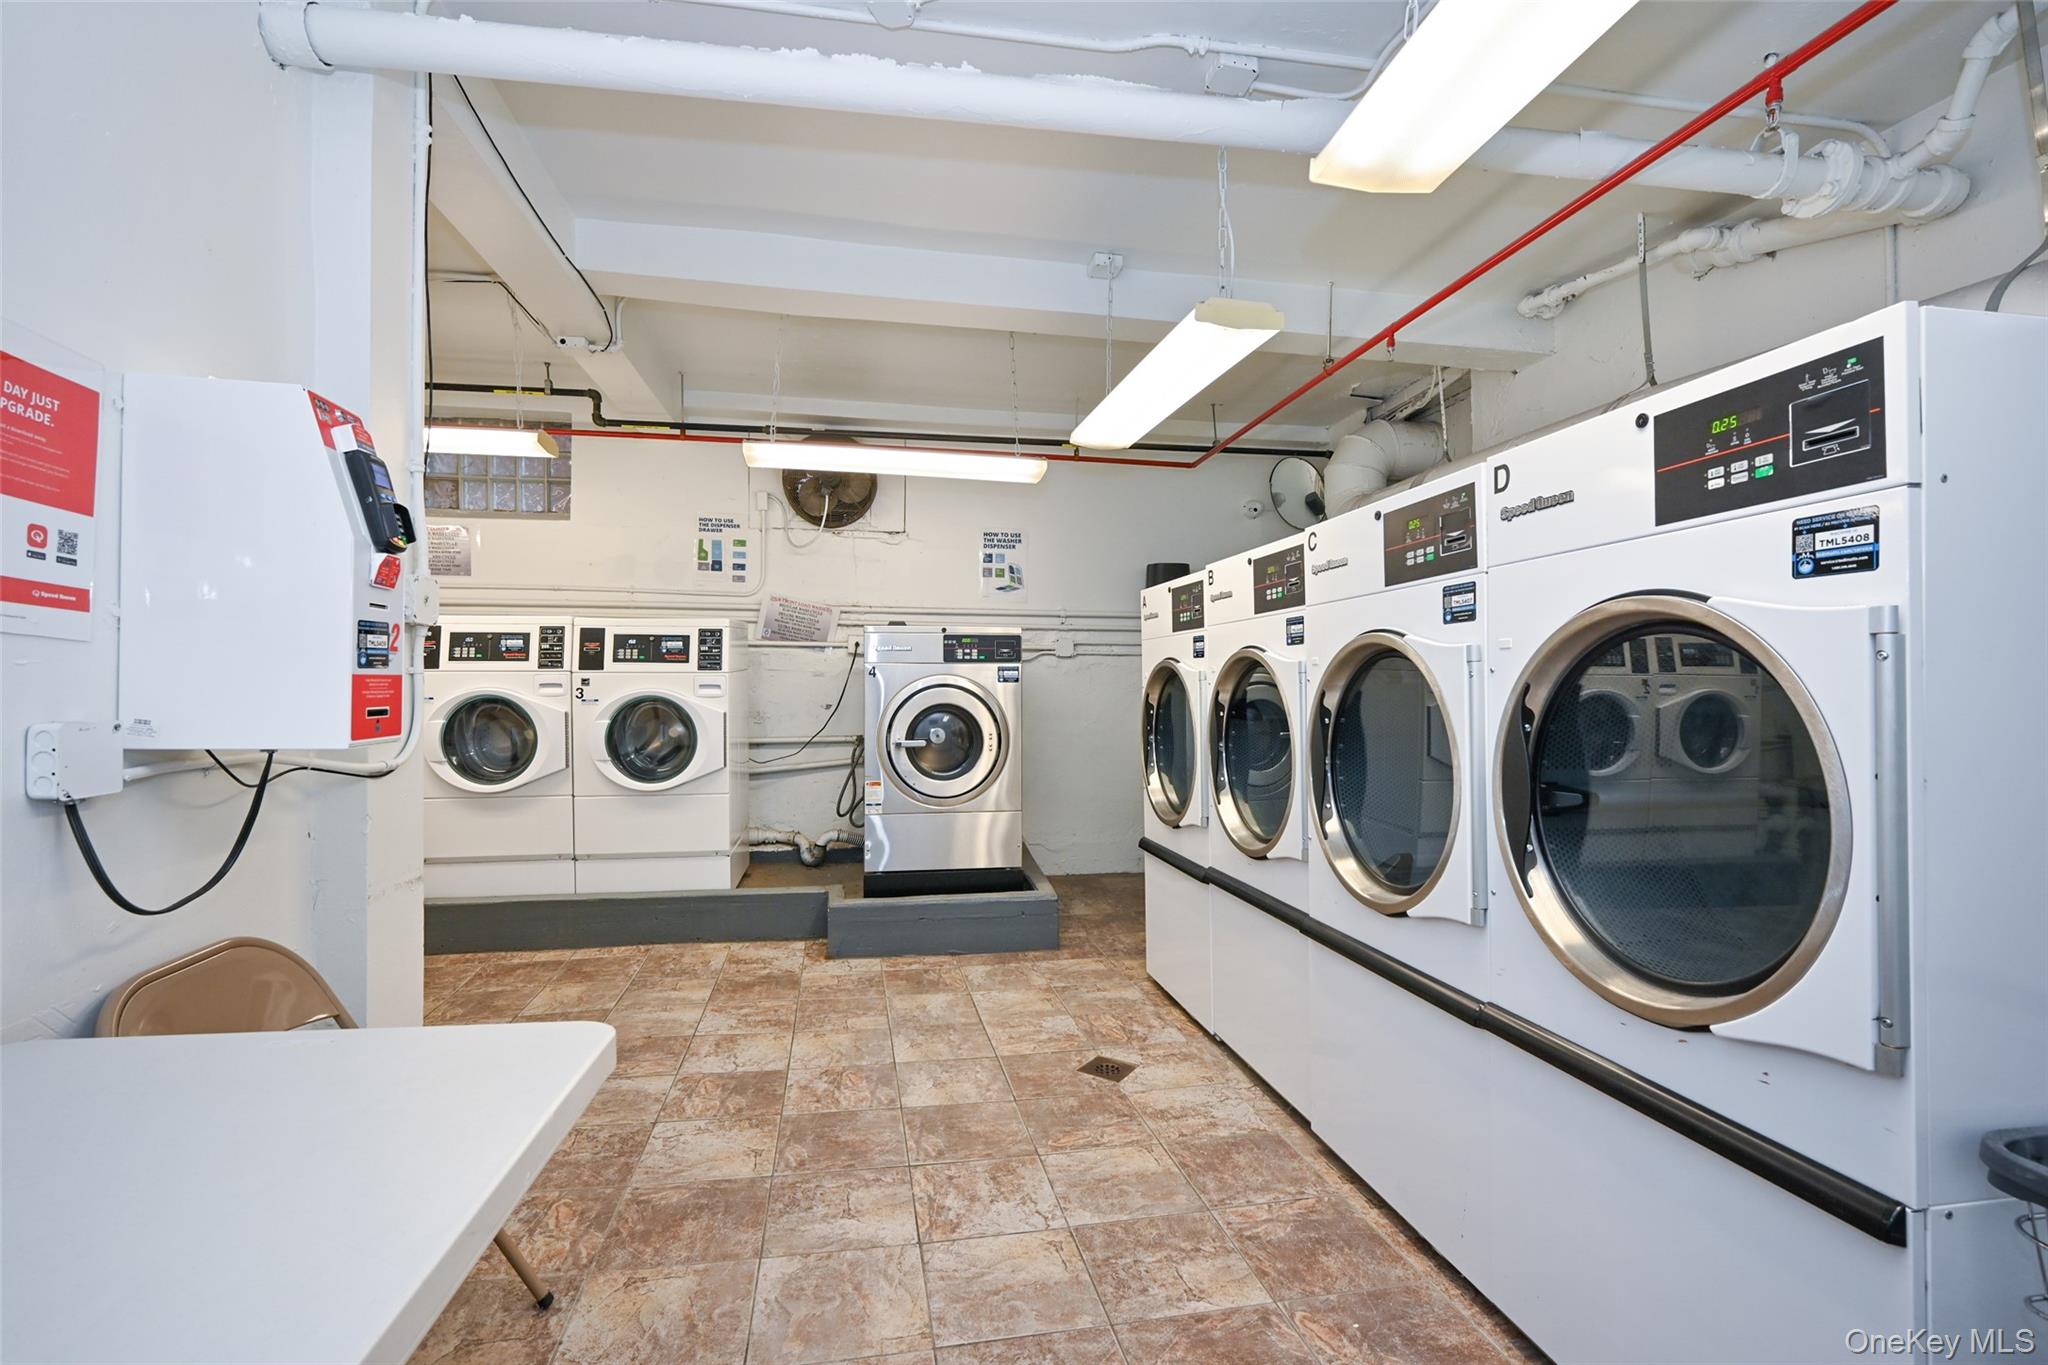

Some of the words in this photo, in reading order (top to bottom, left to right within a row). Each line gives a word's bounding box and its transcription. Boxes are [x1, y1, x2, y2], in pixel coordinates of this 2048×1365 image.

[3, 380, 29, 399] DAY
[30, 391, 60, 412] JUST
[1494, 463, 1511, 494] D
[1308, 532, 1317, 551] C
[1819, 533, 1870, 547] TML5408
[1208, 570, 1214, 585] B
[1142, 595, 1147, 608] A
[390, 623, 400, 651] 2
[868, 666, 876, 678] 4
[575, 687, 584, 699] 3
